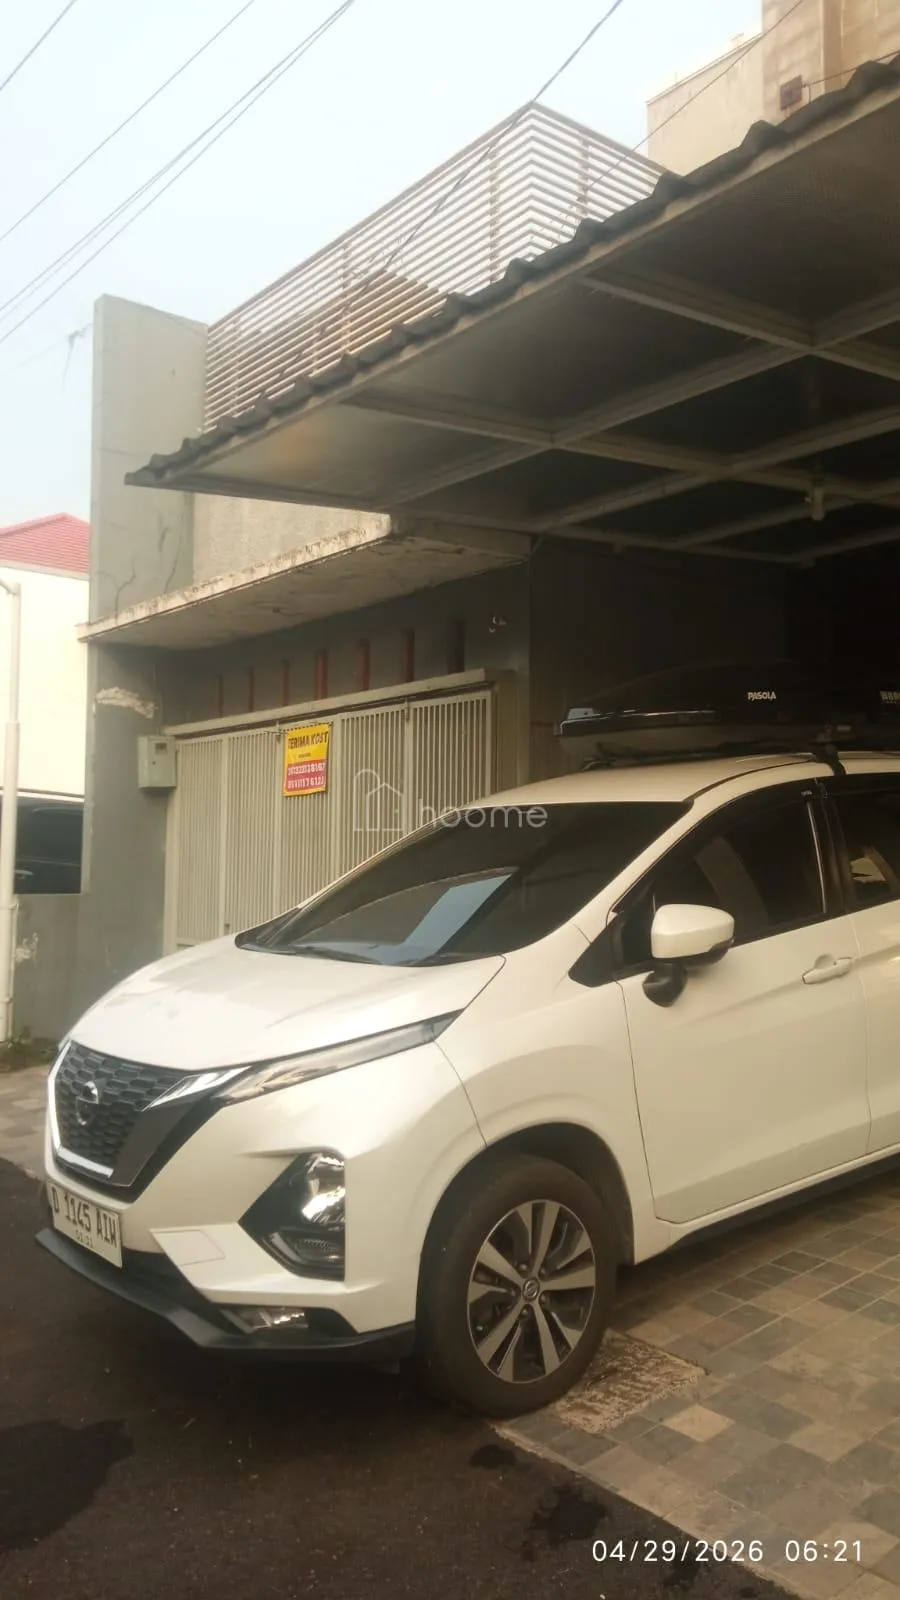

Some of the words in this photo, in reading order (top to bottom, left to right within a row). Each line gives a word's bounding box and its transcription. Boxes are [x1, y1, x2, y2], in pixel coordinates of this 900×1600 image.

[288, 735, 310, 749] TERIMA
[52, 1186, 60, 1213] D
[64, 1192, 92, 1232] 1145
